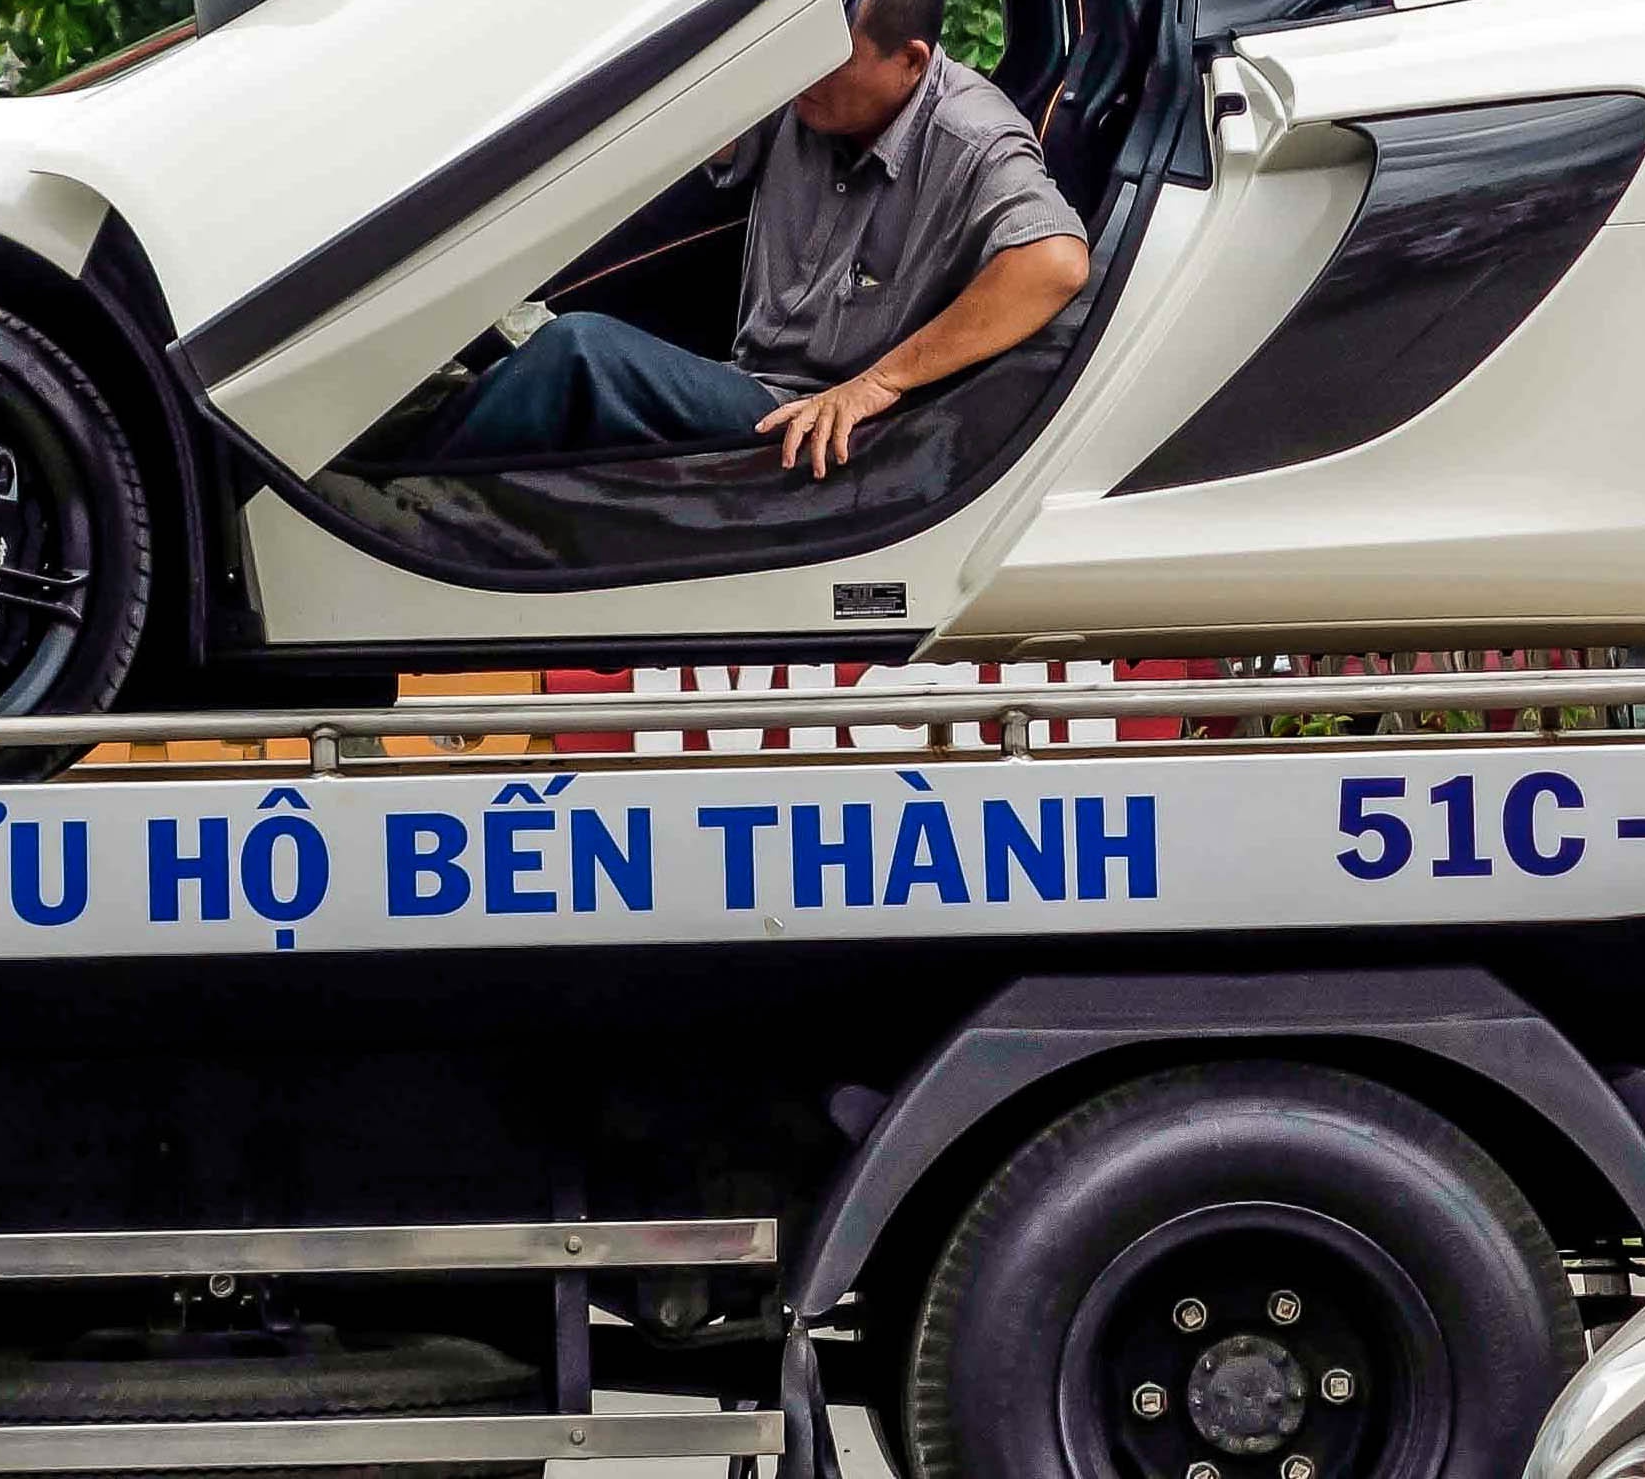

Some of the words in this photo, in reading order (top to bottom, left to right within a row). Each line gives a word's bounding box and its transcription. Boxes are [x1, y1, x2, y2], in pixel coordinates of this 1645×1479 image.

[147, 787, 332, 951] HỘ
[385, 774, 656, 920] BẾN
[698, 769, 1157, 910] THÀNH
